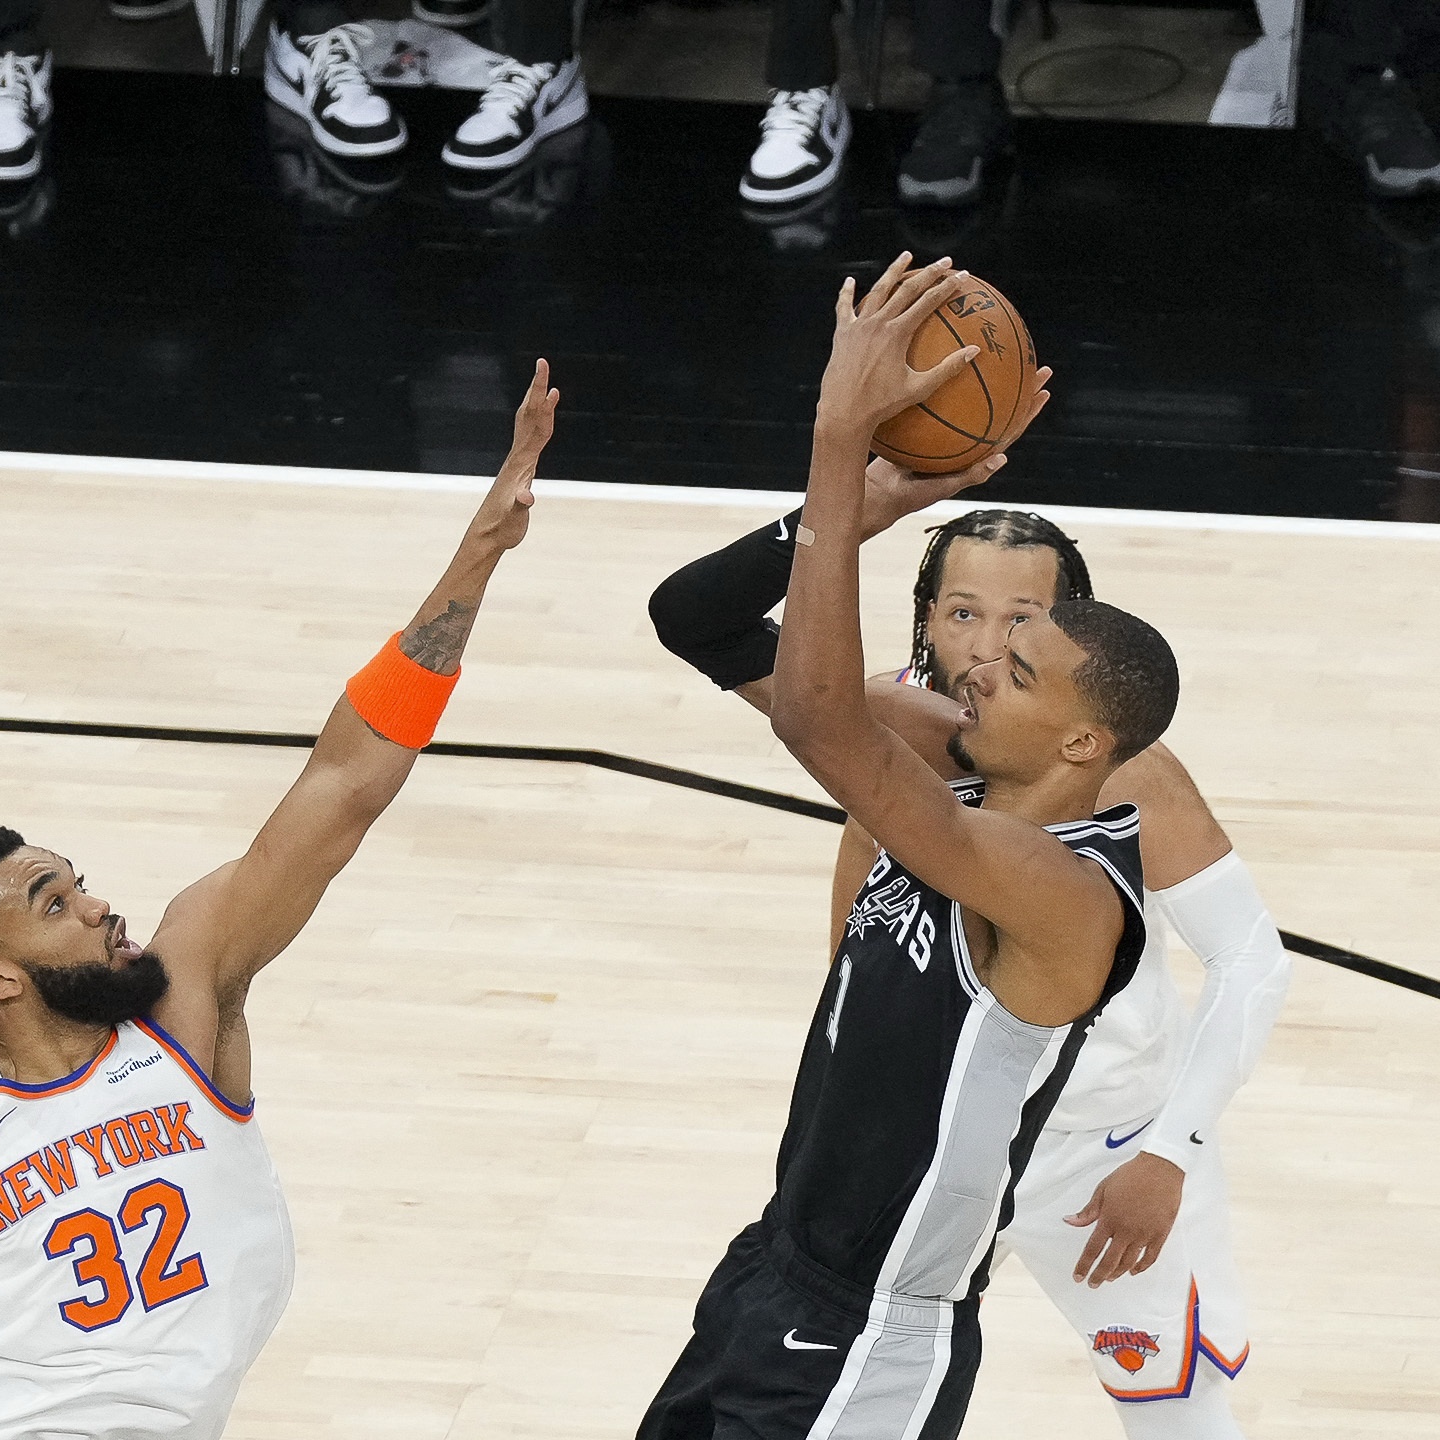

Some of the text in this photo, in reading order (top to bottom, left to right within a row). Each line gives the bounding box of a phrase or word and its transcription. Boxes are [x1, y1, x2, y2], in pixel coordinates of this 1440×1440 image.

[825, 953, 853, 1054] 1
[71, 1101, 206, 1178] YORK
[42, 1177, 209, 1333] 32
